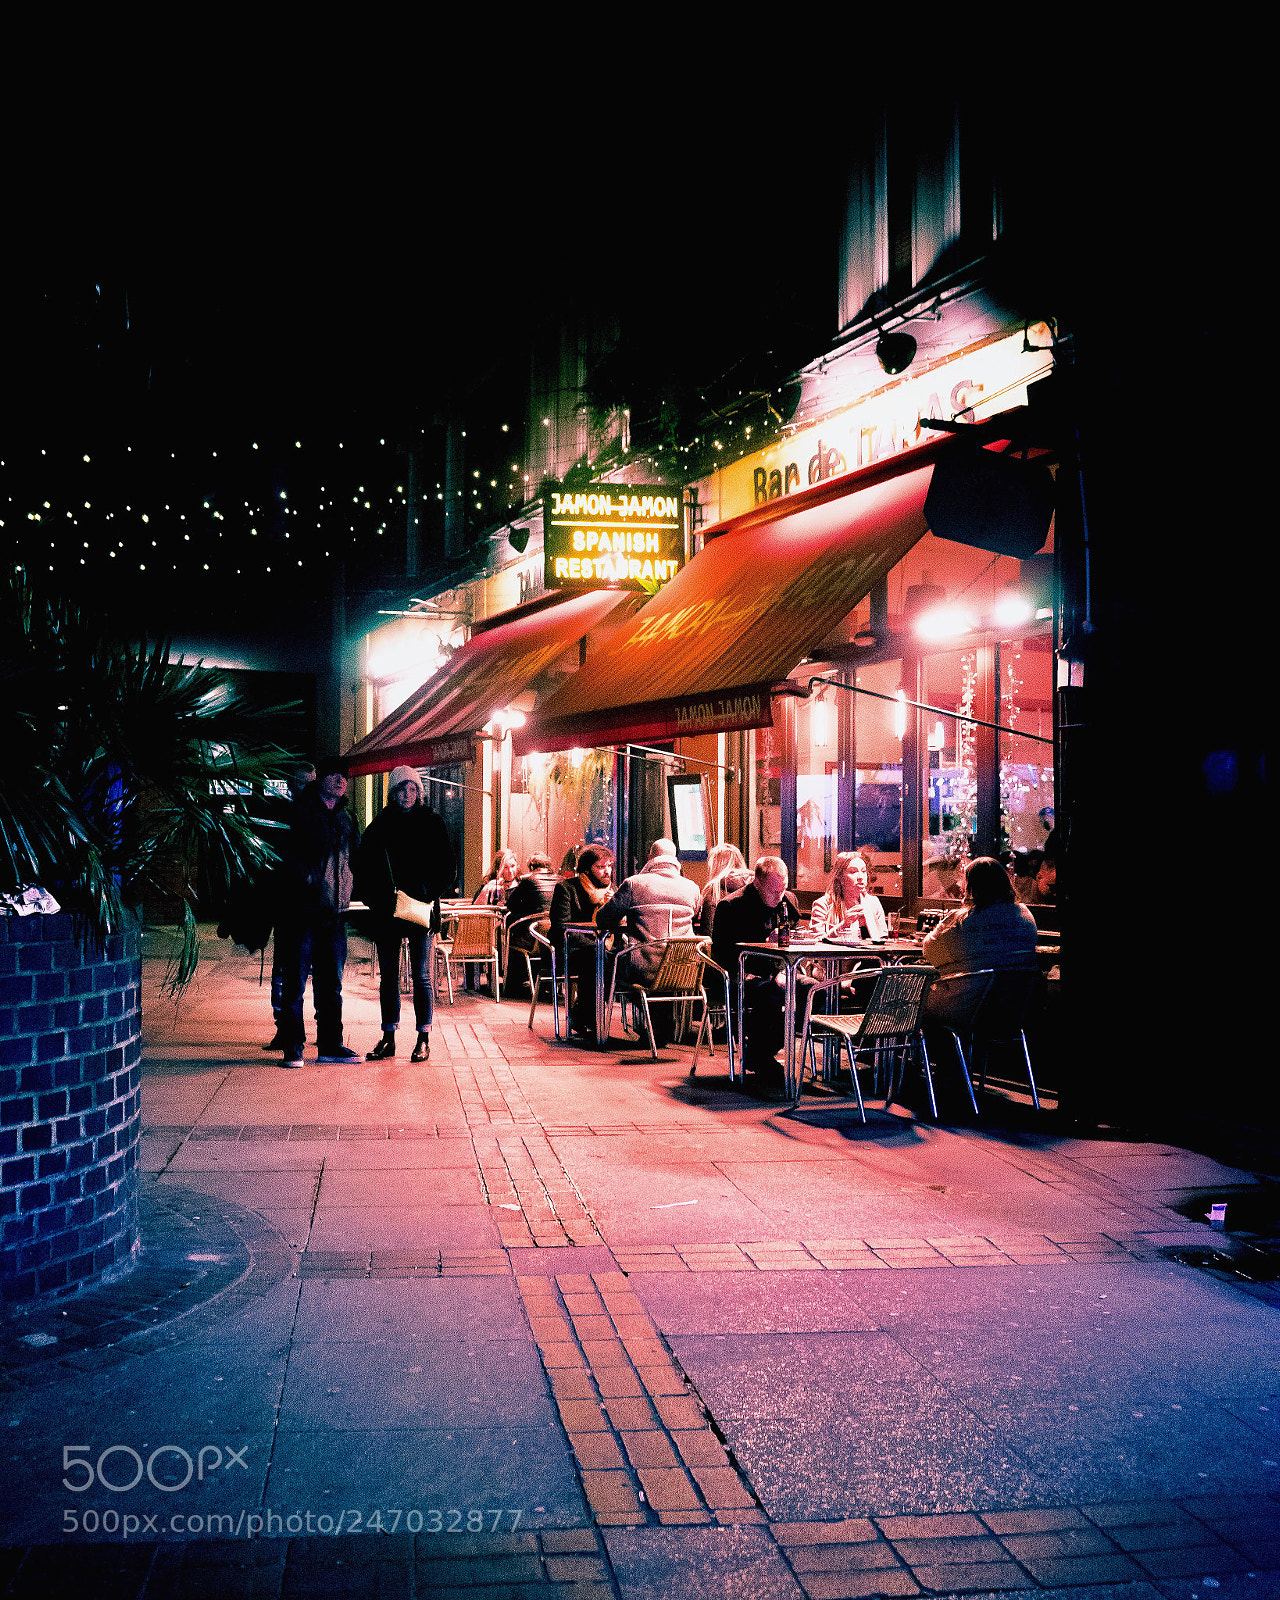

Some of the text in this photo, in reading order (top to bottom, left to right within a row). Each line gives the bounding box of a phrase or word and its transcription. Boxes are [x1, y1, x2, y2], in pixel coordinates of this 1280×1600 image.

[753, 378, 984, 504] Bar de TAAS
[573, 531, 659, 552] SPANISH
[555, 557, 678, 580] RESTAURANT
